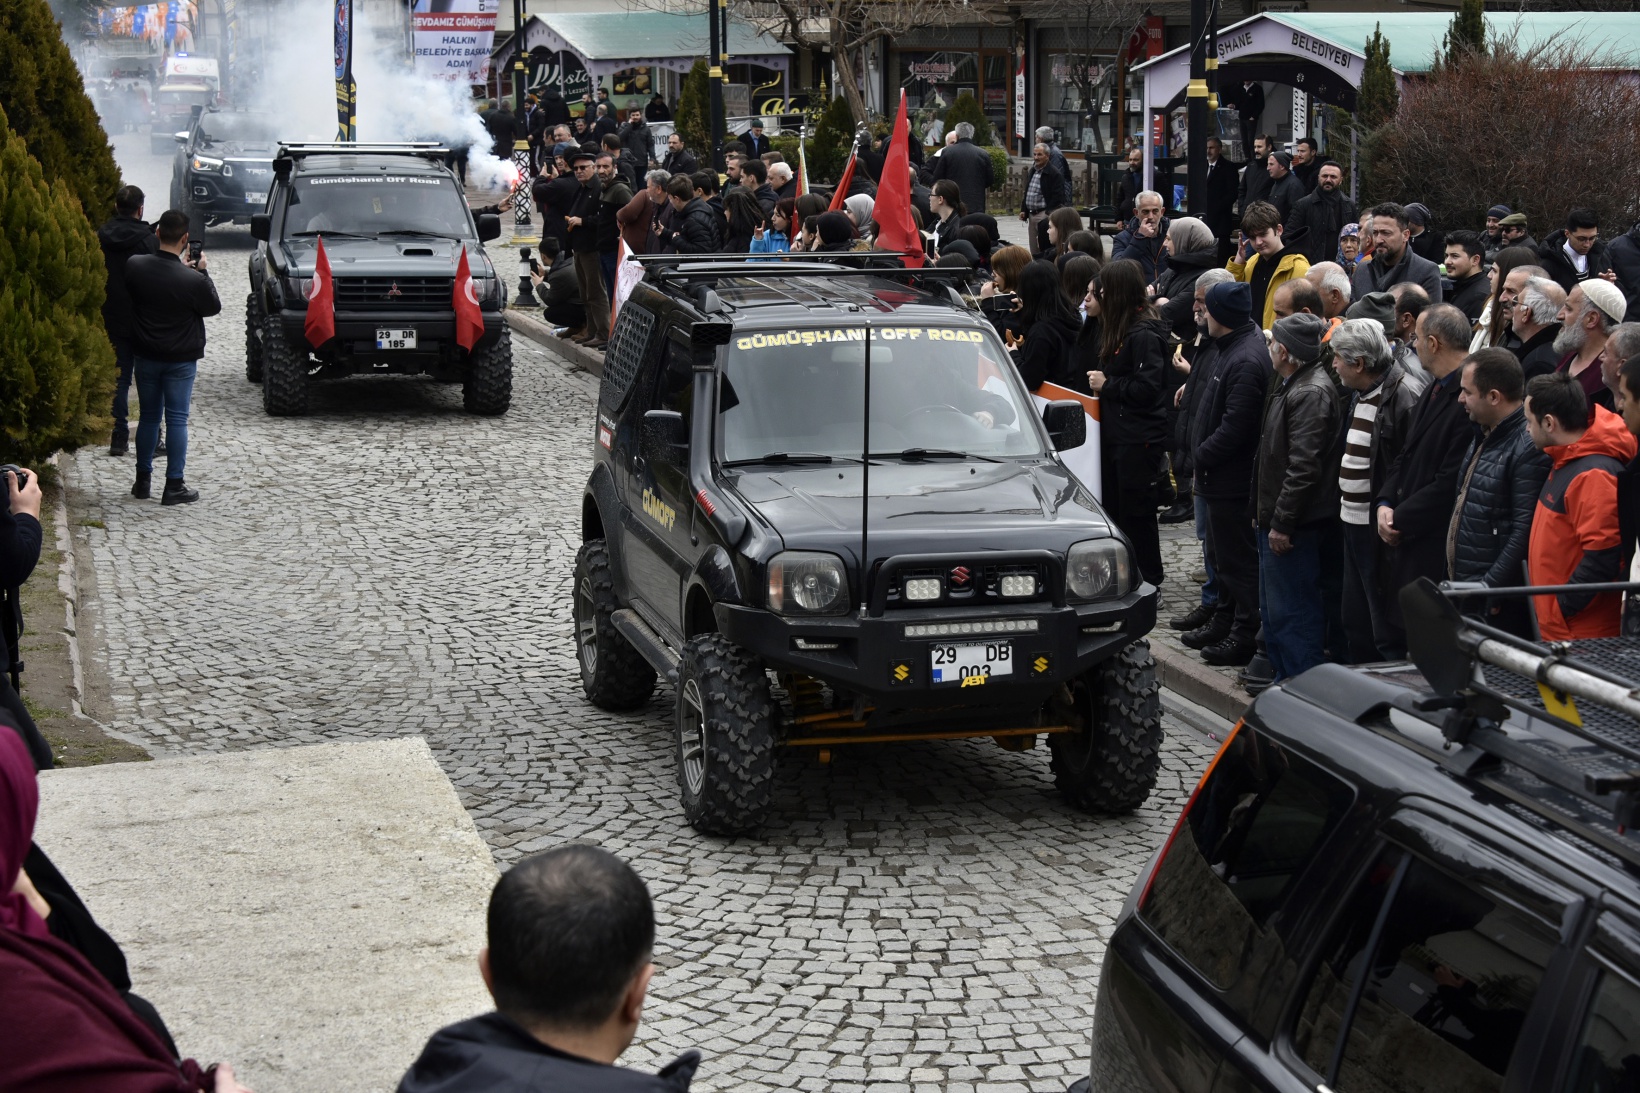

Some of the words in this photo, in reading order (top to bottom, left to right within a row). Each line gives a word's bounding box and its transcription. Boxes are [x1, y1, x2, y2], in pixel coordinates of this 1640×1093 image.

[1148, 28, 1162, 39] FOTO
[442, 36, 477, 44] HALKIN
[415, 46, 463, 56] BELEDİYE
[1291, 33, 1352, 69] BELEDİYESİ
[446, 60, 473, 68] ADAYI
[310, 176, 384, 185] Gümüşhane
[409, 177, 441, 185] Road
[378, 331, 391, 339] 29
[402, 330, 415, 339] DR
[736, 328, 877, 350] GÜMÜŞHANE
[880, 328, 923, 340] OFF
[926, 329, 984, 343] ROAD
[388, 340, 406, 348] 185
[935, 646, 957, 664] 29
[985, 645, 1010, 662] DB
[961, 674, 988, 688] ABT
